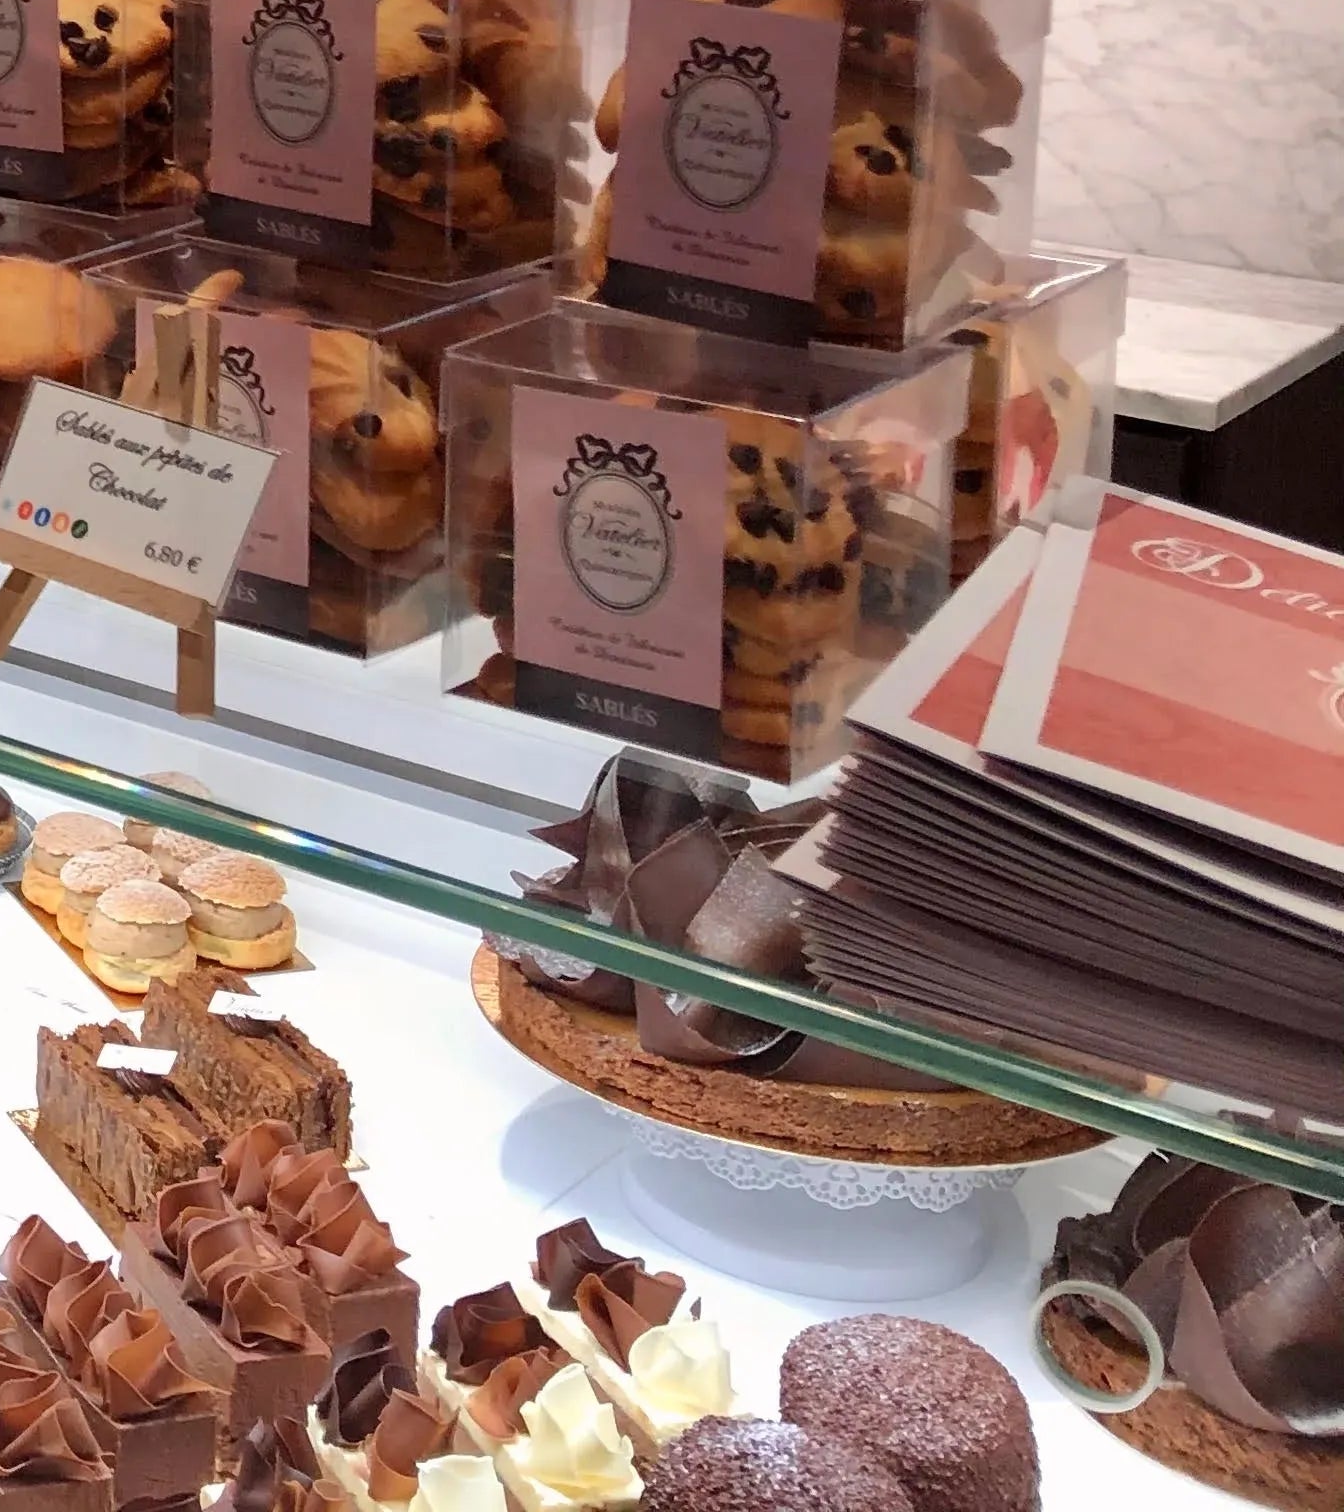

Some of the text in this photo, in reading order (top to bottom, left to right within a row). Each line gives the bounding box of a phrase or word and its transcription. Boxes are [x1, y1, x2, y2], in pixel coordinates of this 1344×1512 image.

[56, 409, 235, 485] Sablés aux pépites de
[87, 461, 169, 512] Chocolat
[144, 541, 203, 575] 6,80 €
[575, 691, 658, 729] SABLÉS
